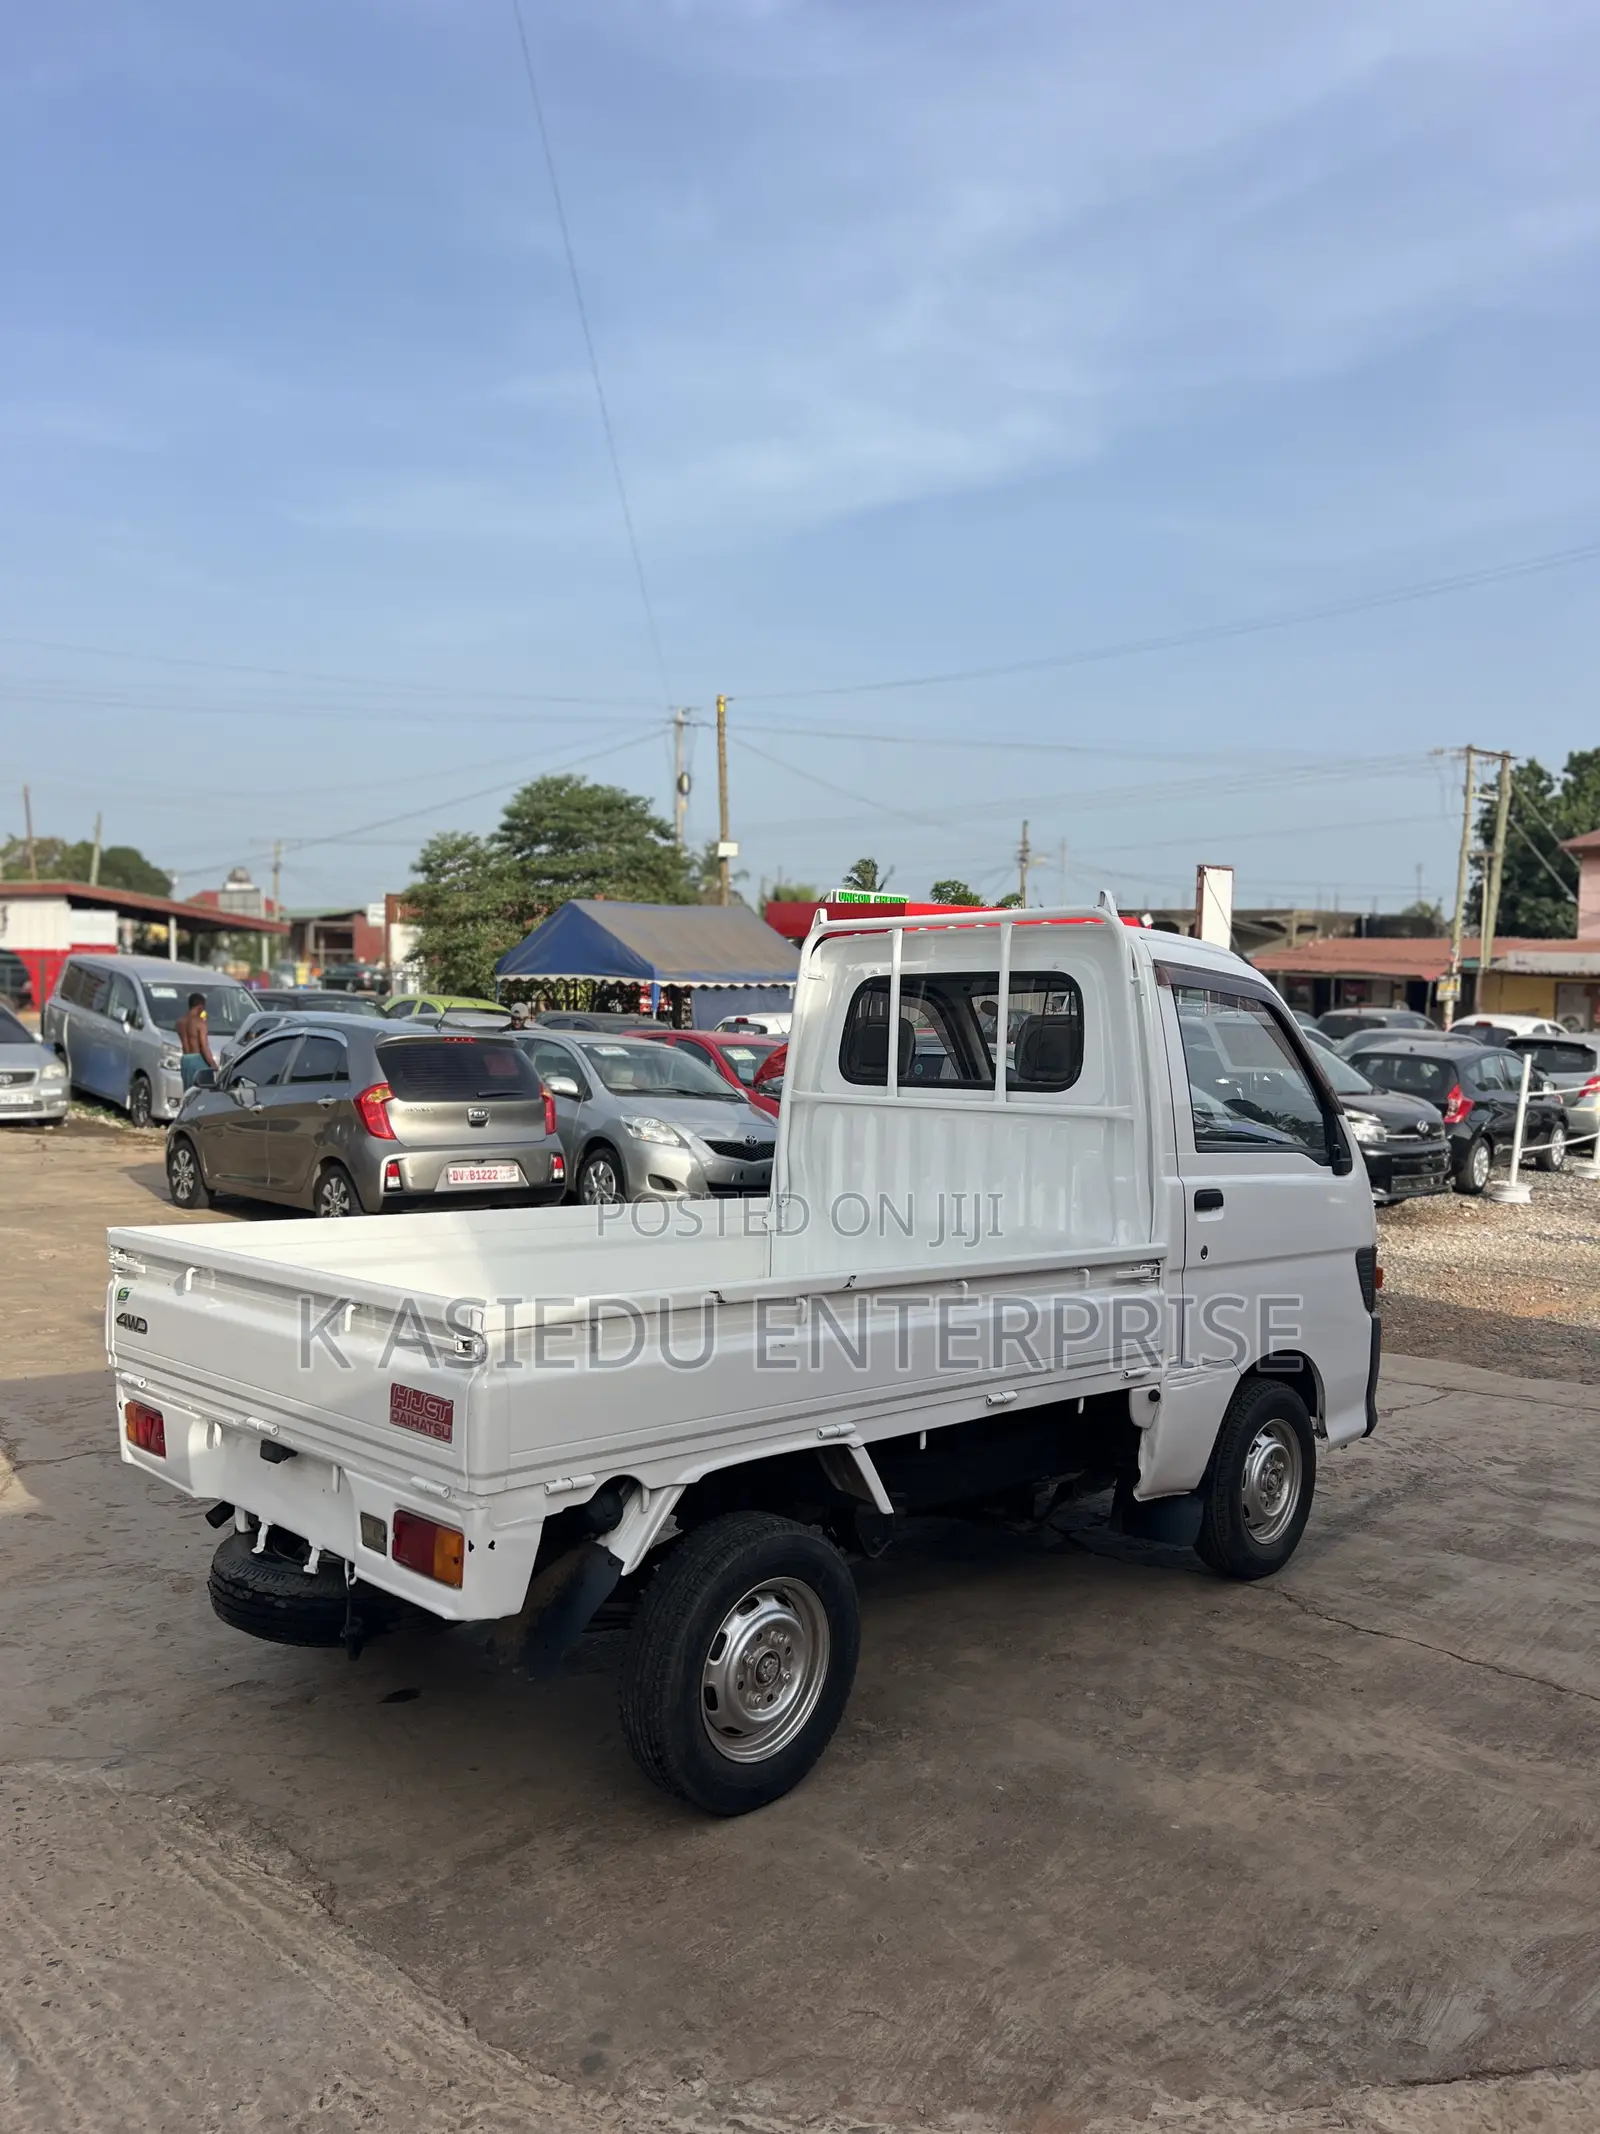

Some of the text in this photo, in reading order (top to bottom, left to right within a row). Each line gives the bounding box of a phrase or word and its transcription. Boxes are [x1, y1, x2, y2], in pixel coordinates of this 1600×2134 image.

[472, 1110, 486, 1119] KIA
[452, 1170, 464, 1181] DV
[469, 1169, 498, 1180] B1222
[116, 1312, 148, 1335] 4WD
[391, 1409, 451, 1441] DAIHATSU
